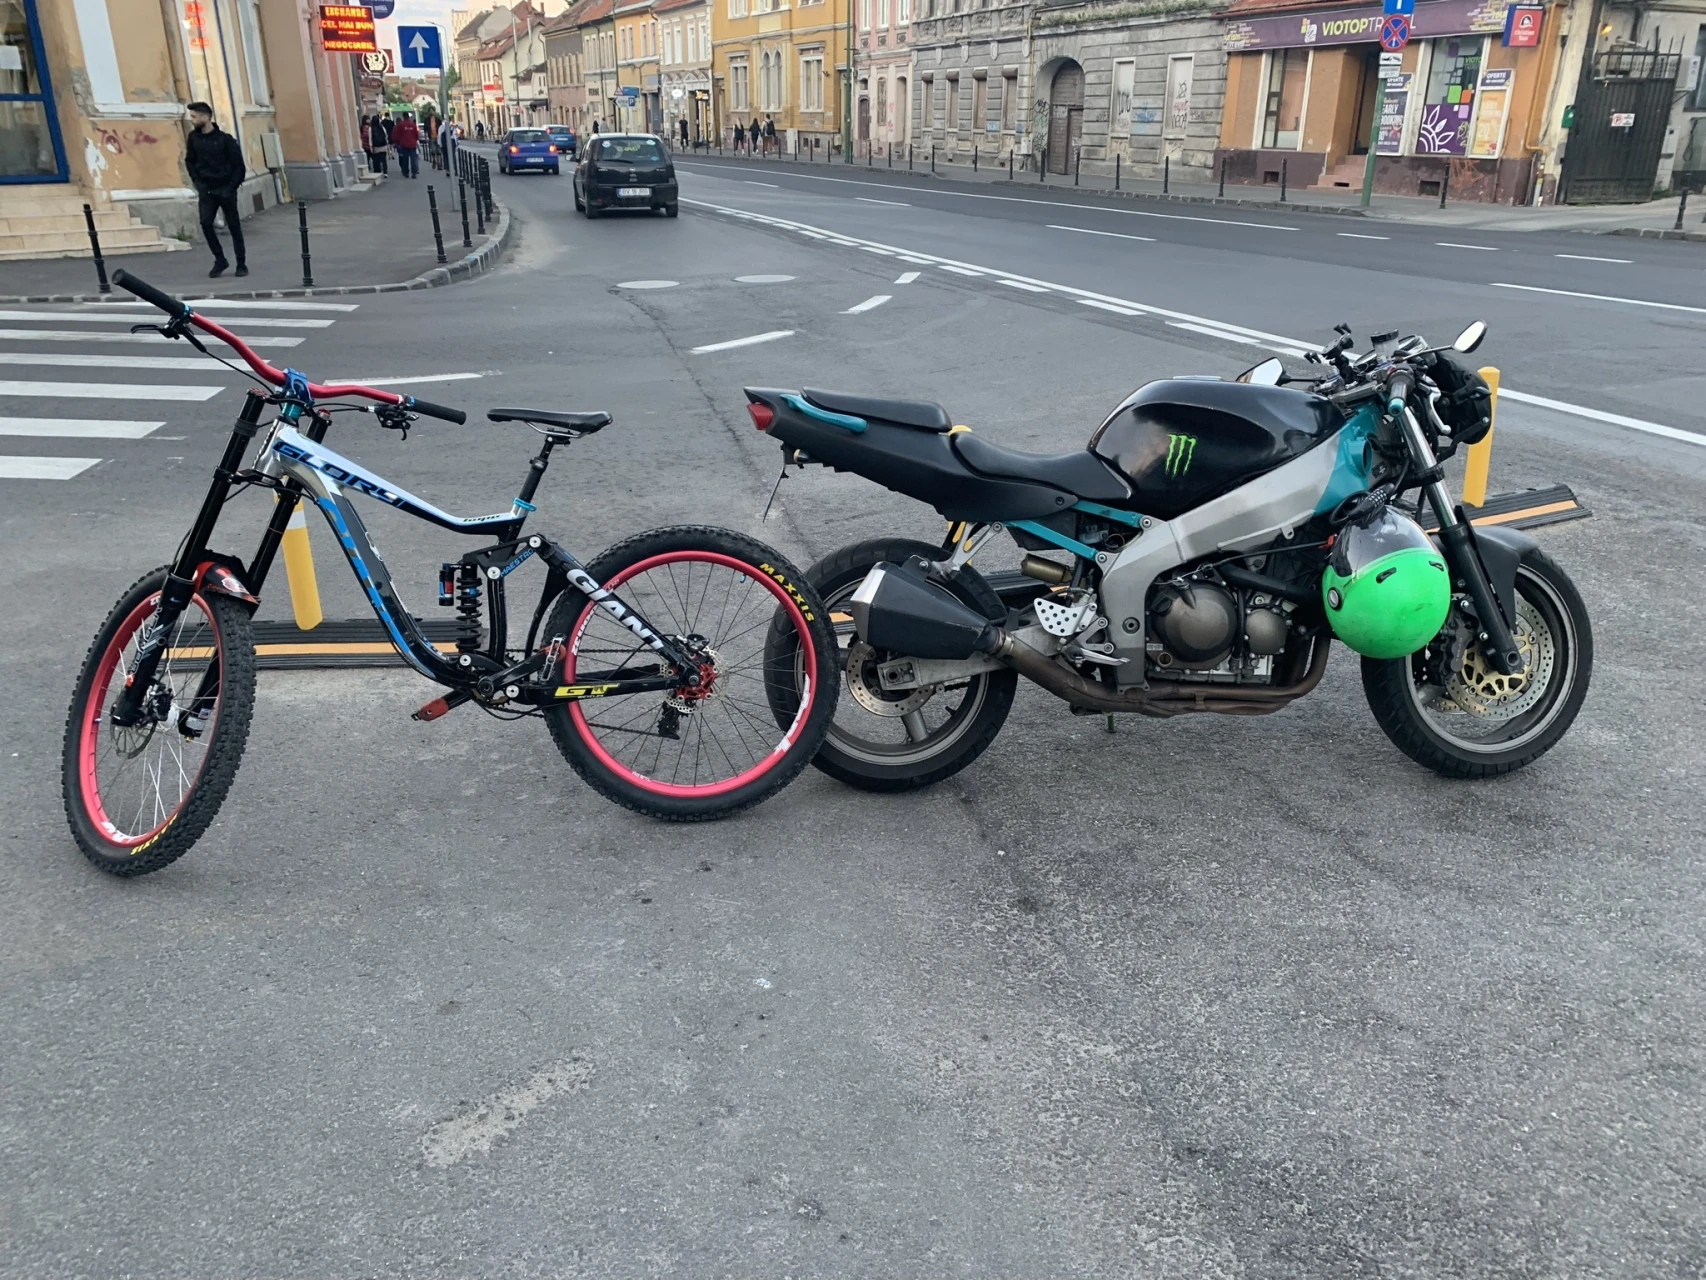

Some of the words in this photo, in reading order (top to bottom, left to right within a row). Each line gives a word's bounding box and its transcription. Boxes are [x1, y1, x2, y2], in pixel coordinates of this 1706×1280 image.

[321, 20, 338, 28] CEL
[338, 21, 354, 29] MAI
[1322, 13, 1417, 36] VIOTOPTRL
[366, 51, 384, 63] SEX
[272, 439, 406, 508] GLORY
[500, 547, 534, 577] MAESTRO
[760, 563, 814, 621] MAXXIS
[566, 569, 664, 649] GIANT
[555, 683, 620, 697] GT
